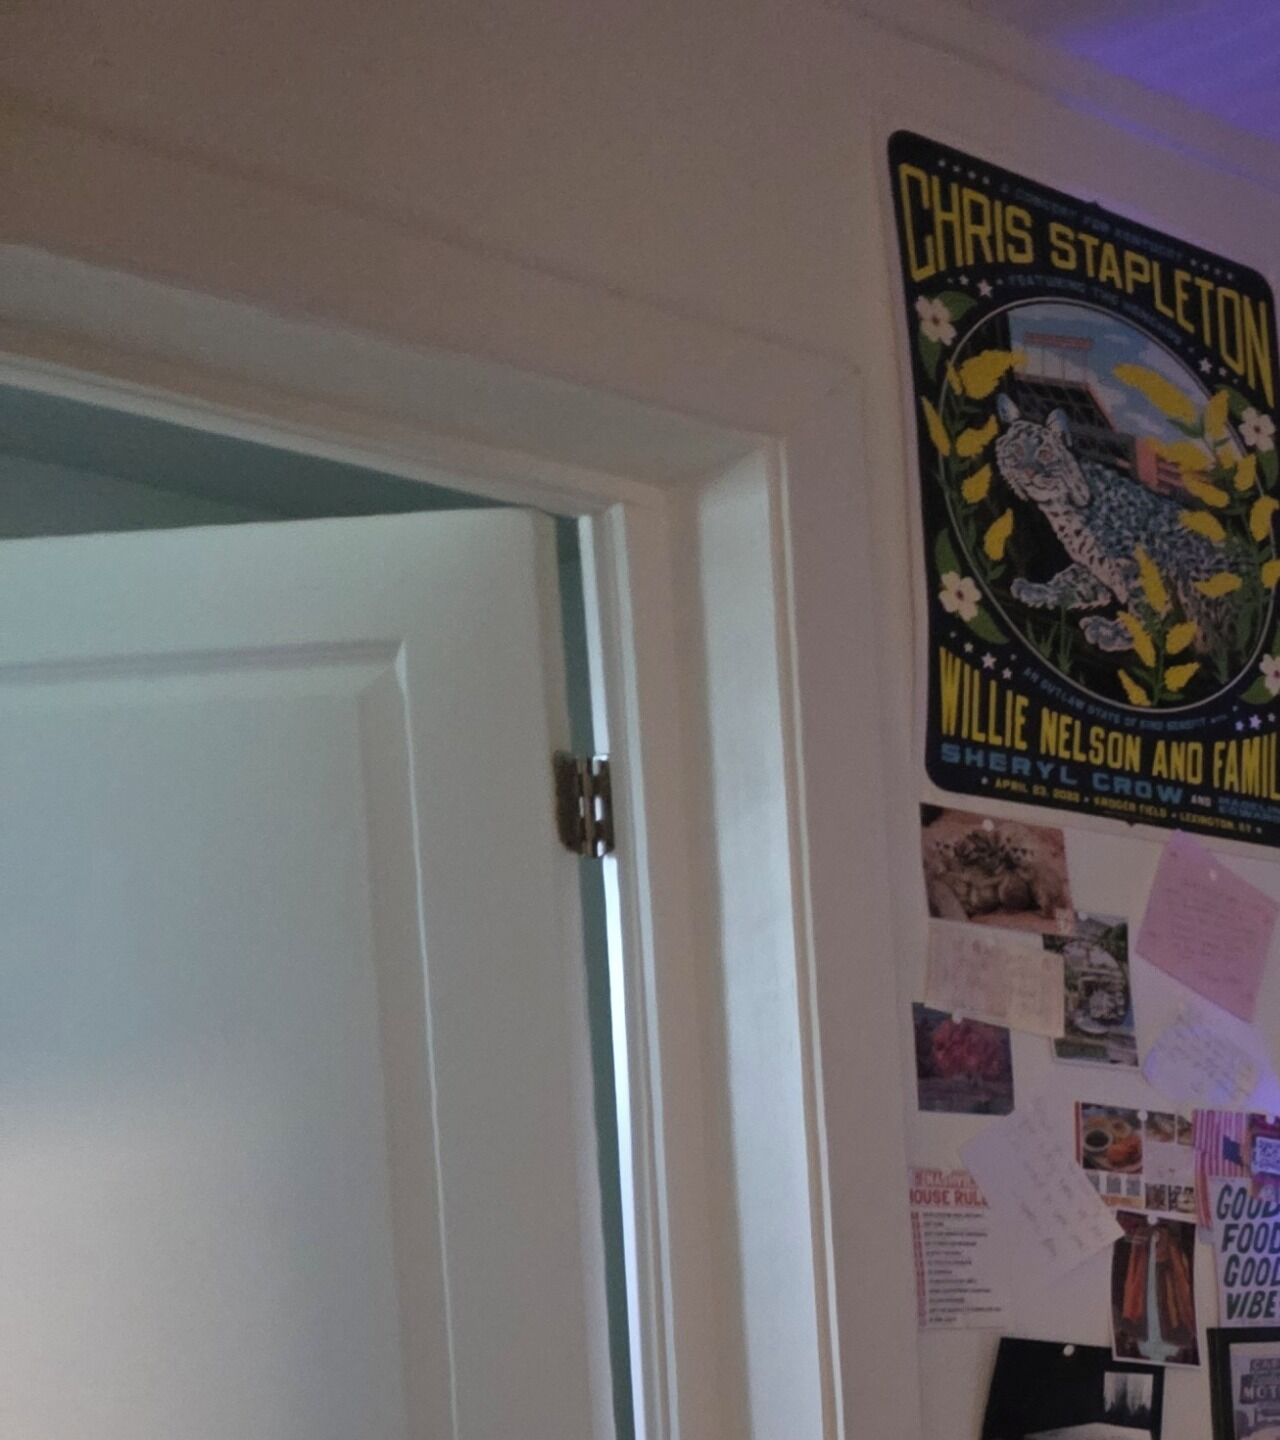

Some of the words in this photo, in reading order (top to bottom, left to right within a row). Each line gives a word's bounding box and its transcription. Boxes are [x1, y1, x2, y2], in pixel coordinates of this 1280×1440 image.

[899, 163, 1035, 282] CHRIS
[1048, 222, 1275, 408] STAPLETON
[938, 646, 1030, 752] WILLIE
[1038, 706, 1142, 774] NELSON
[1151, 737, 1203, 786] AND
[1039, 678, 1086, 712] OUTLAW
[940, 743, 1079, 786] SHERYL
[1091, 771, 1184, 804] CROW
[1190, 793, 1212, 808] AND
[993, 777, 1029, 795] APRIL
[1138, 804, 1169, 819] FIELD
